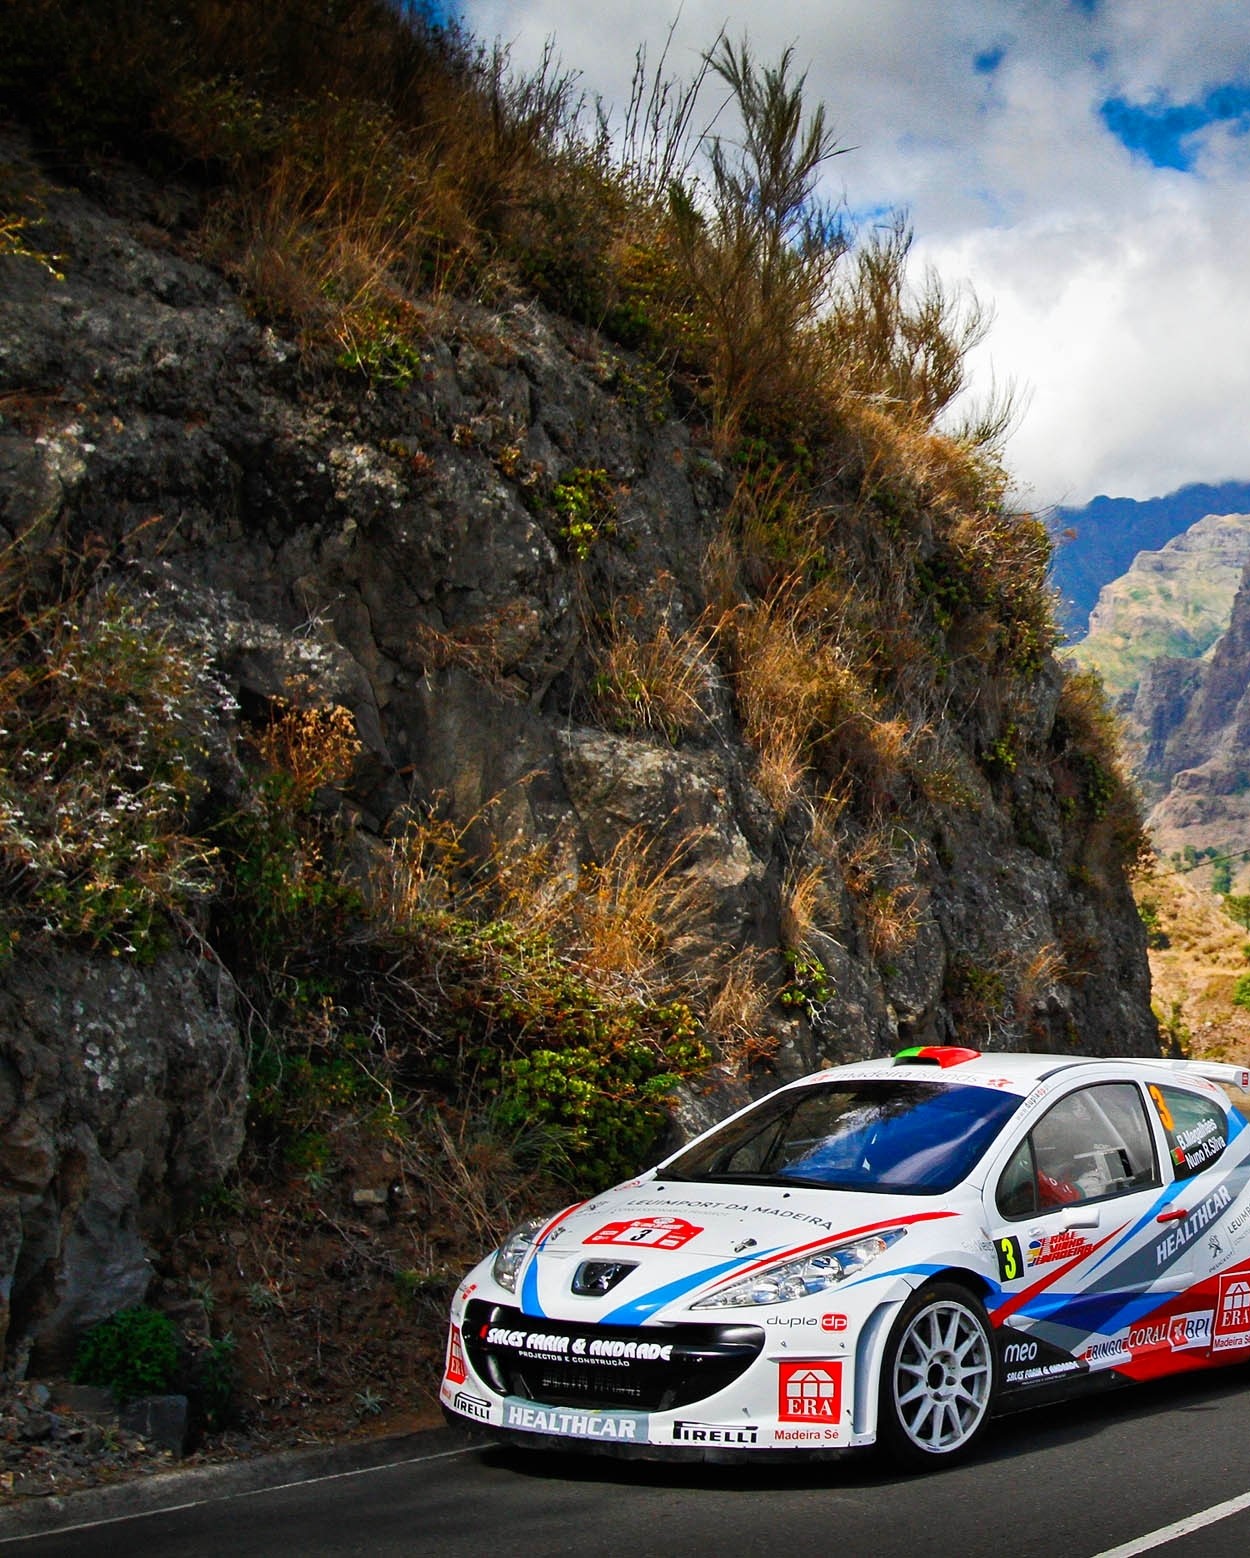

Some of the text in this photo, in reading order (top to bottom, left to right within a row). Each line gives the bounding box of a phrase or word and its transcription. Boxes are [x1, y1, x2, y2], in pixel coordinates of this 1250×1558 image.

[1149, 1085, 1175, 1131] 3
[1185, 1136, 1227, 1170] Nuno R.Silva
[725, 1203, 749, 1213] DA
[748, 1206, 832, 1231] MADEIRA
[1156, 1185, 1231, 1265] HEALTHCAR
[630, 1229, 653, 1241] 3
[1001, 1237, 1017, 1280] 3
[766, 1315, 818, 1328] dupla
[1186, 1318, 1209, 1339] BPI
[1221, 1308, 1249, 1327] ERA
[487, 1328, 674, 1361] SALES FARIA & ANDRADE
[1128, 1324, 1167, 1348] CORAL
[1215, 1337, 1243, 1348] Madeira
[518, 1350, 563, 1362] PROJECTOS
[1004, 1342, 1038, 1363] meo
[454, 1392, 492, 1420] PIRELLI
[787, 1398, 833, 1416] ERA
[508, 1406, 636, 1439] HEALTHCAR
[673, 1420, 759, 1443] PIRELLI
[775, 1429, 839, 1440] Madeira Sé
